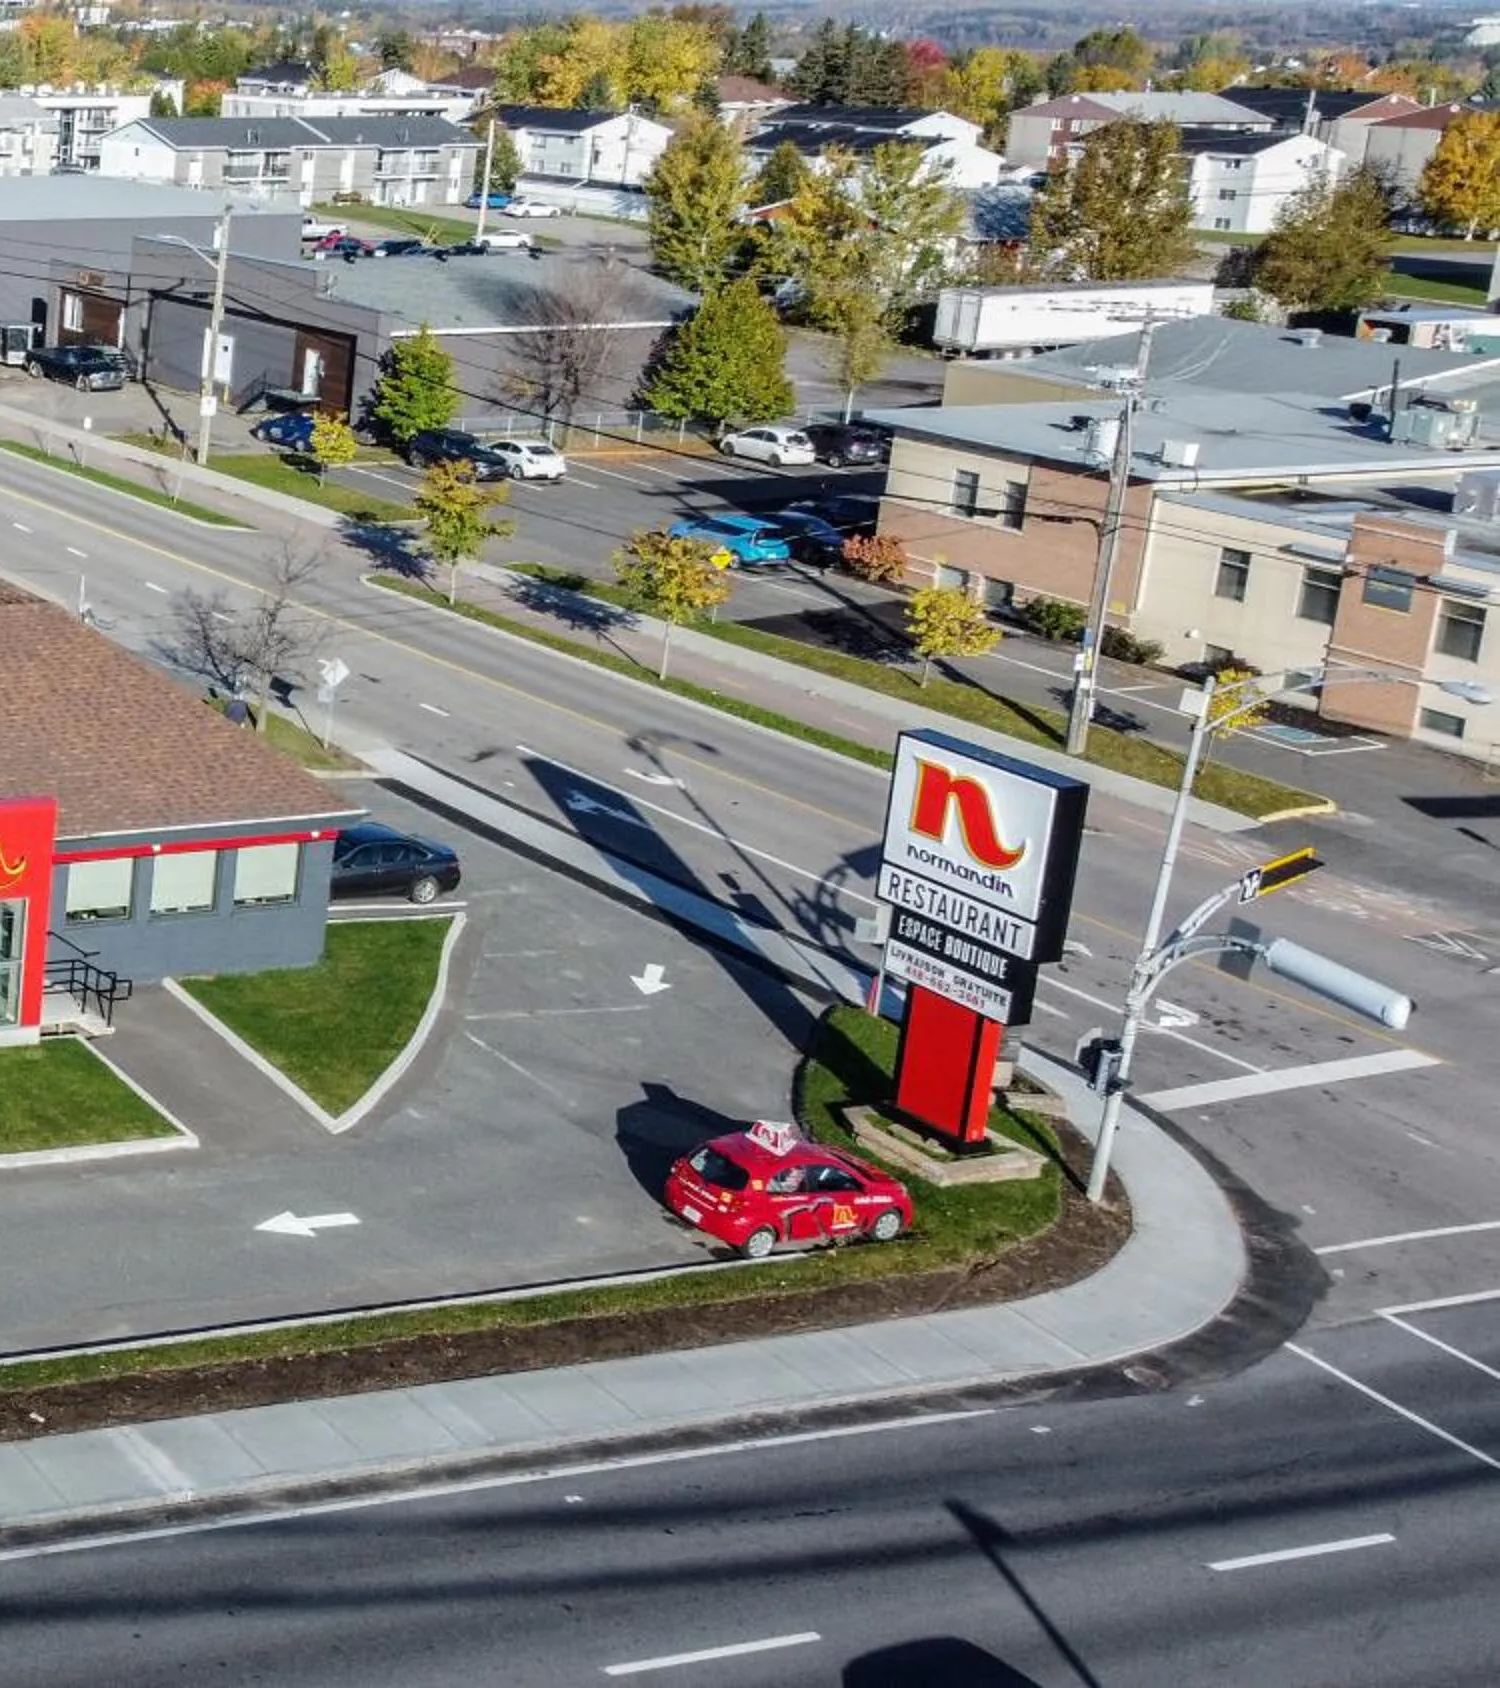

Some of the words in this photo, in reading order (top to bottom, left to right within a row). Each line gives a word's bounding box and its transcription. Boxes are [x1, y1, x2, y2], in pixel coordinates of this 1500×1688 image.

[906, 843, 1014, 898] normandin
[887, 872, 1023, 950] RESTAURANT
[889, 945, 946, 978] LIVRAISON
[952, 974, 1007, 1007] GRATUITE
[897, 915, 944, 951] ESPACE
[943, 935, 1008, 980] BOUTIQUE
